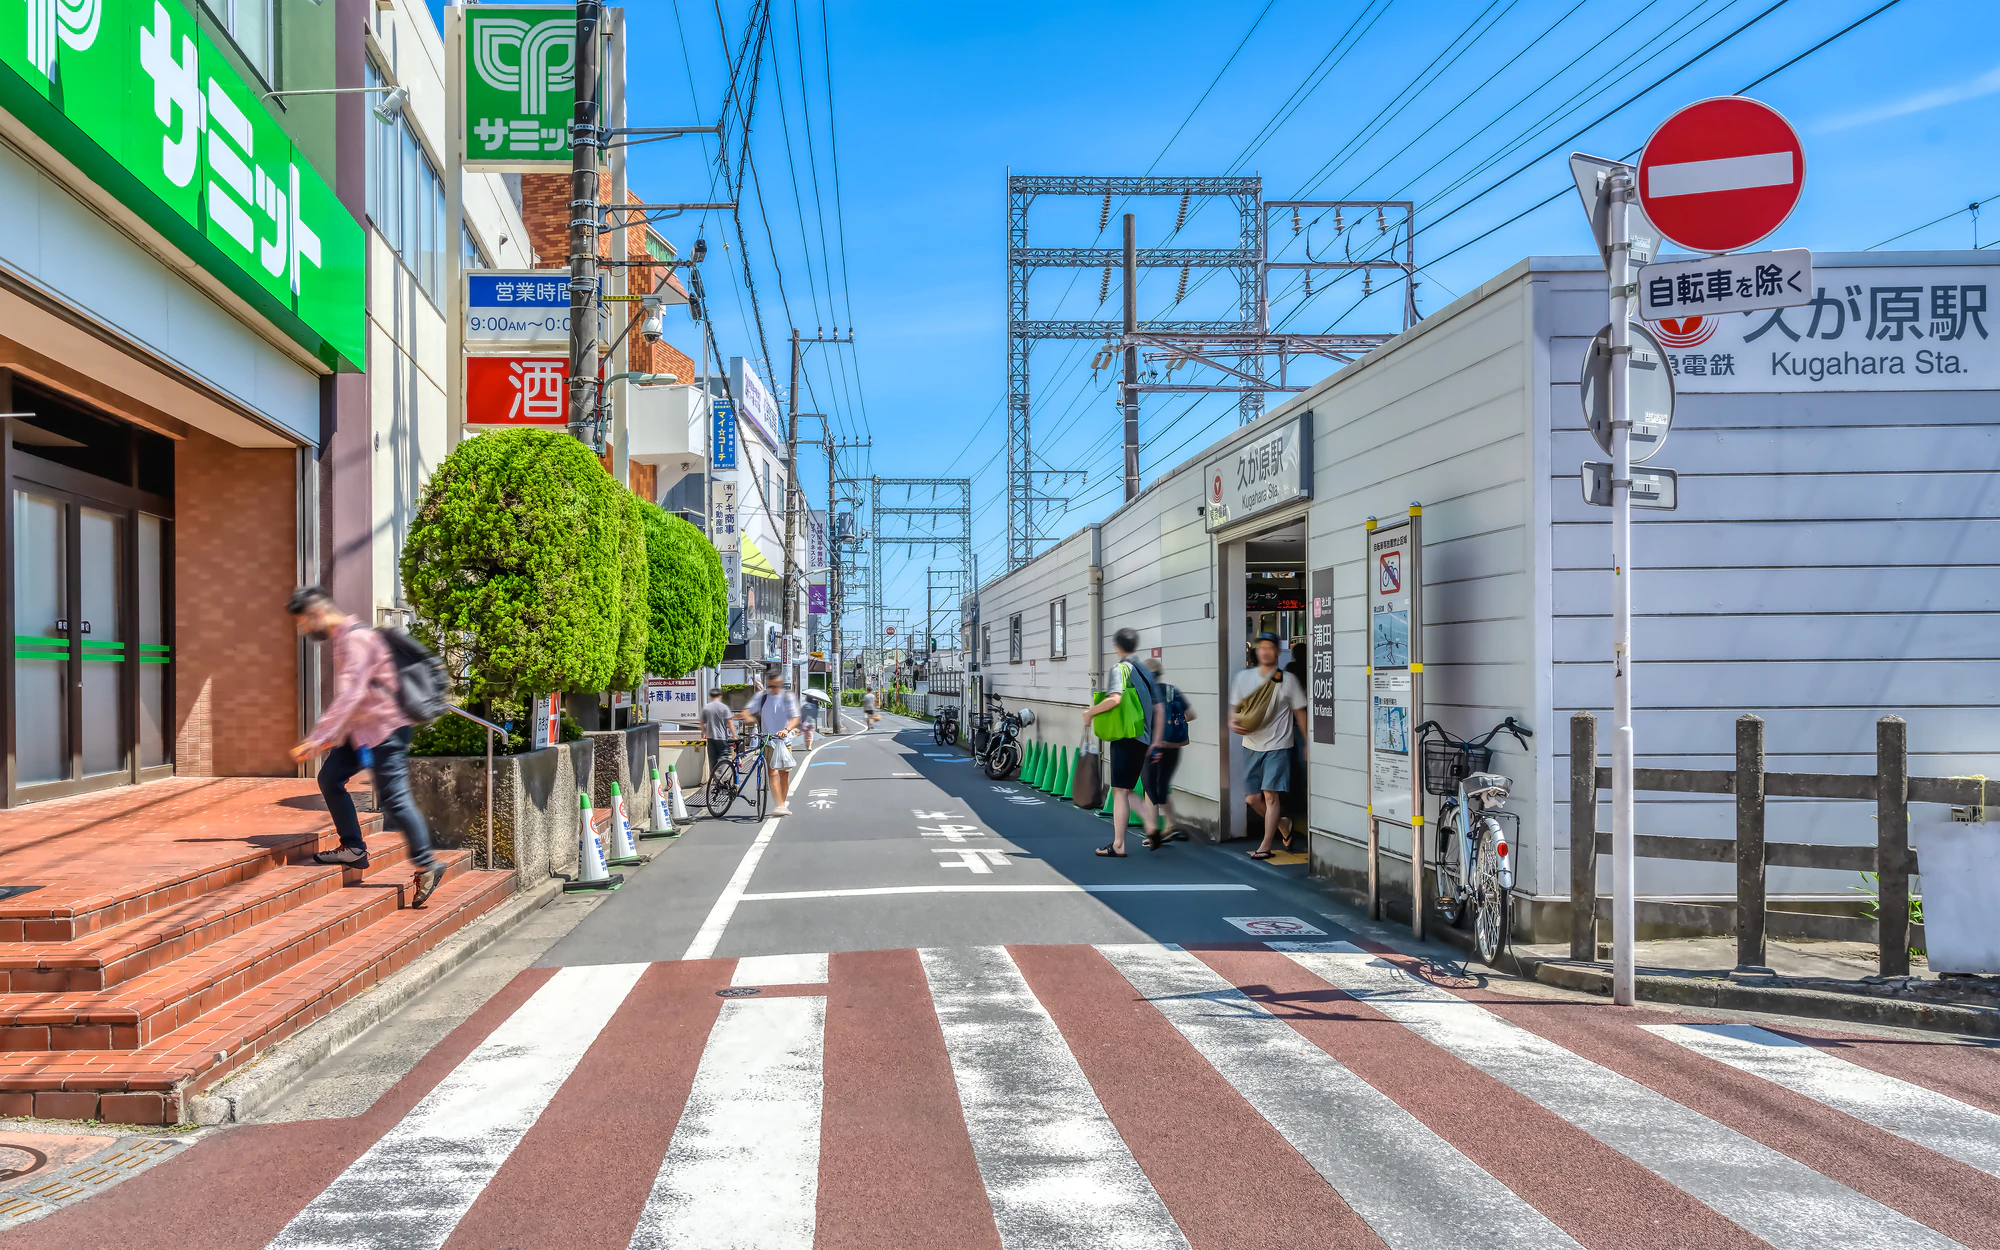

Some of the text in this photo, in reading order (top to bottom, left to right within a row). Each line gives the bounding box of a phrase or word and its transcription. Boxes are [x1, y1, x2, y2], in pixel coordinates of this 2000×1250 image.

[140, 0, 321, 297] サミット
[1649, 265, 1803, 308] 自転車を除く
[1771, 350, 1968, 381] Kugahara Sta.
[508, 361, 564, 419] 酒
[1236, 436, 1284, 492] 久が原駅
[1241, 490, 1267, 511] Kugahara
[715, 502, 724, 535] 不動産部
[1313, 623, 1332, 647] 蒲田
[1313, 650, 1332, 673] 方面
[1313, 677, 1333, 700] のりば
